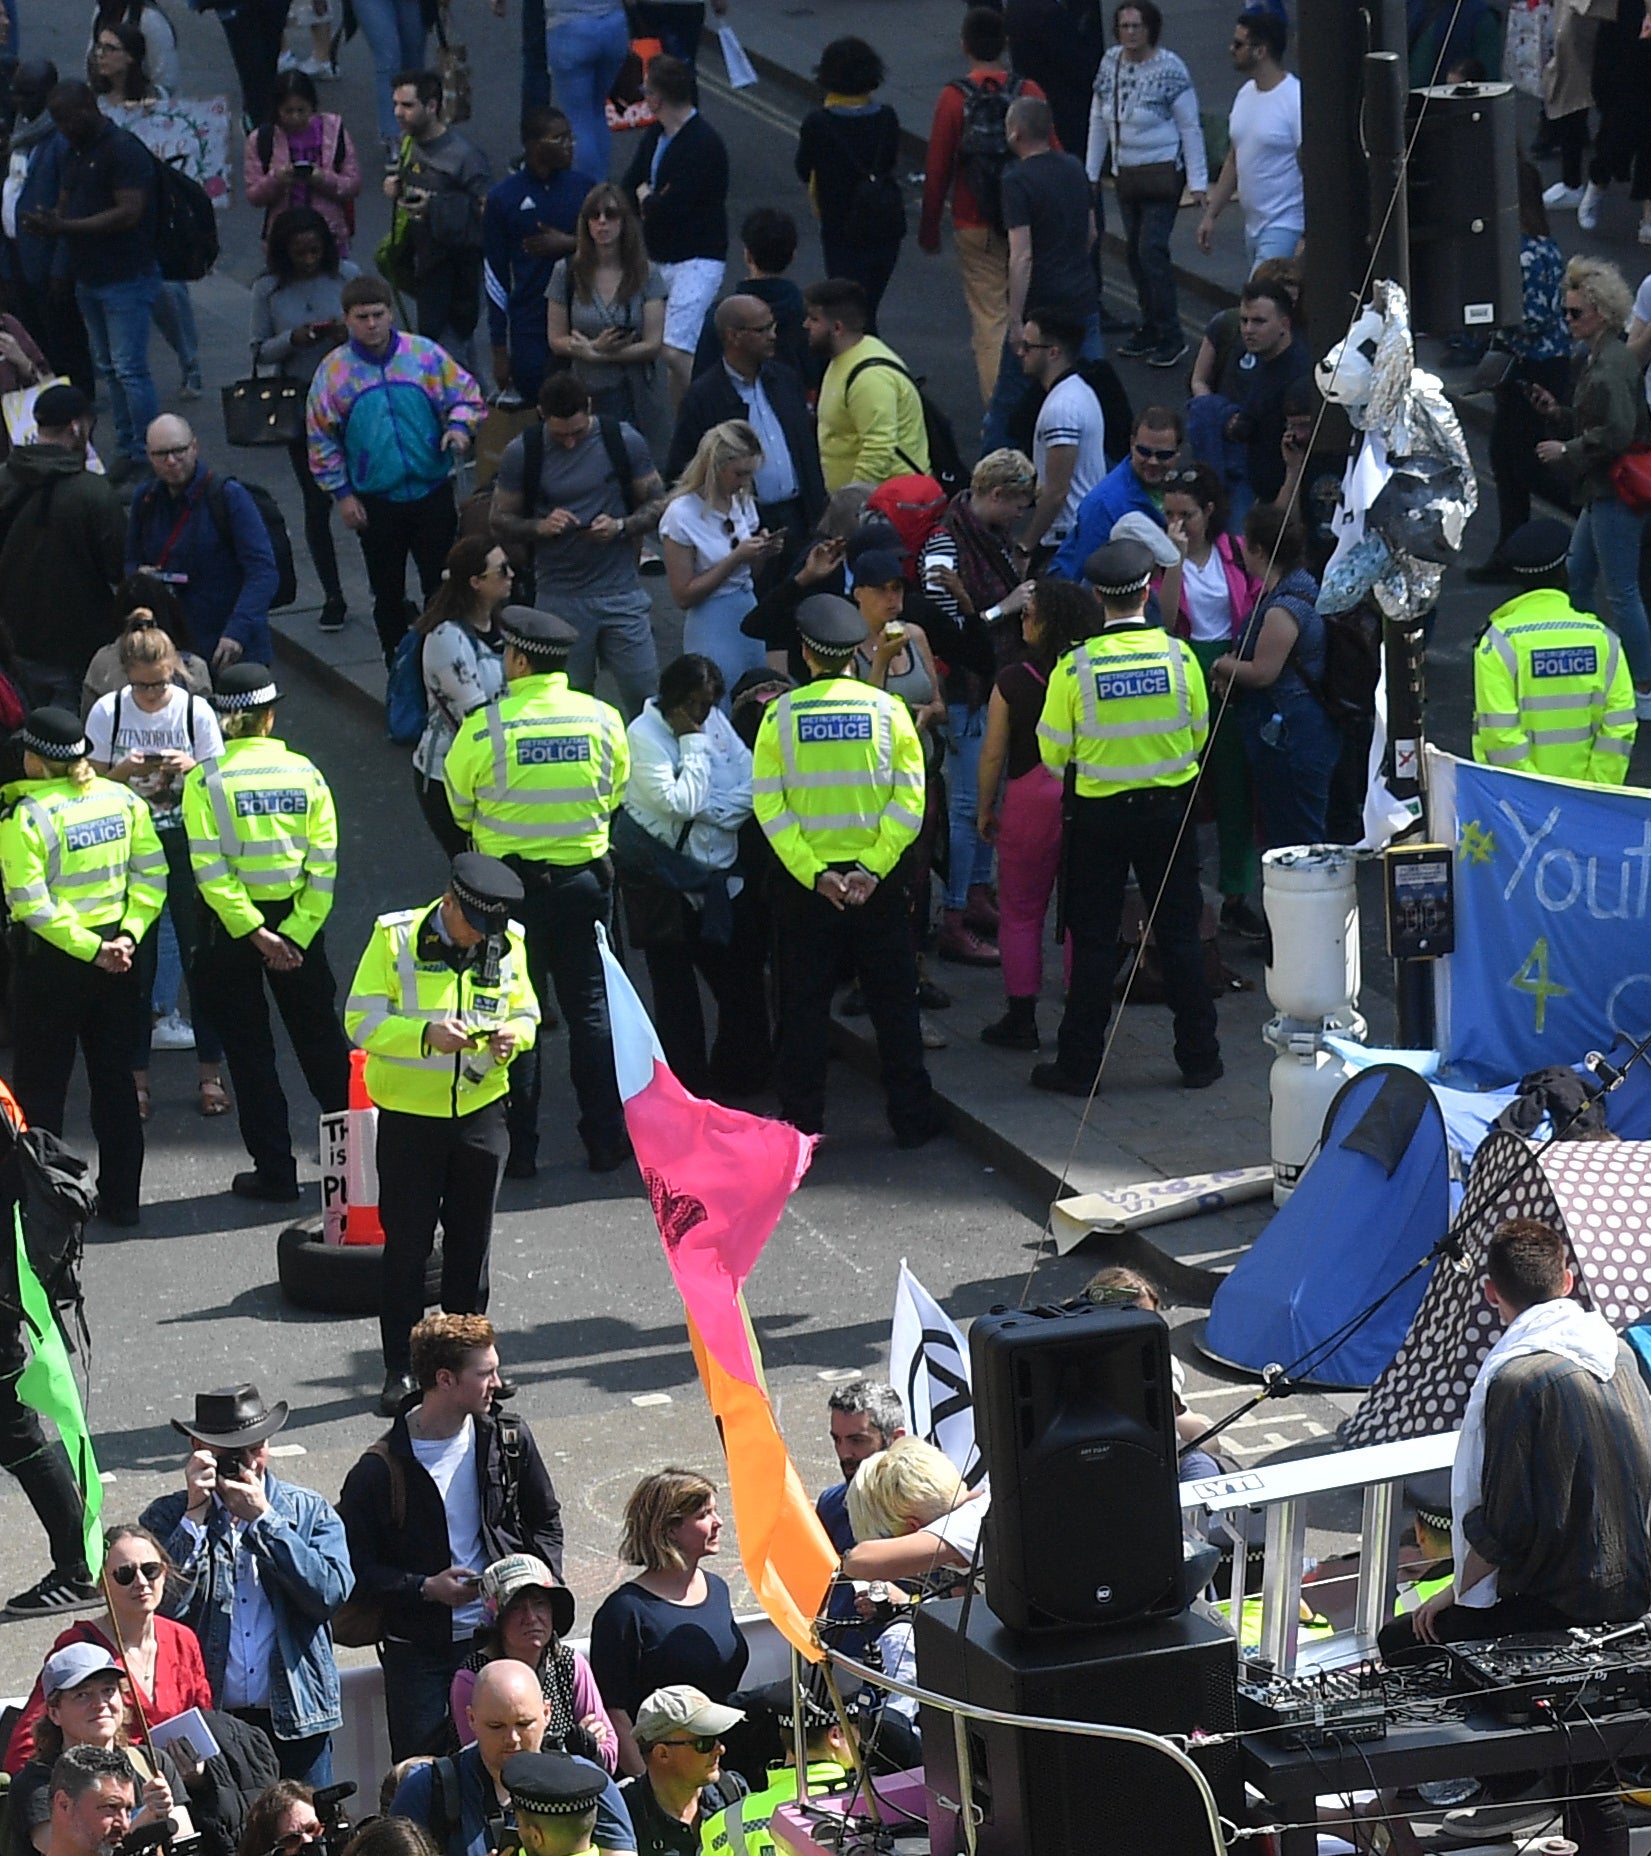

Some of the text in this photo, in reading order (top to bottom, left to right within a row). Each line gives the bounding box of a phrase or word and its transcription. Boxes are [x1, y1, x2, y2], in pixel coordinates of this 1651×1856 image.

[1097, 668, 1168, 683] METROPOLITAN
[1532, 657, 1597, 676] POLICE
[1099, 679, 1171, 699] POLICE
[800, 715, 869, 727] METROPOLITAN
[800, 724, 871, 741] POLICE
[519, 746, 589, 764] POLICE
[236, 798, 307, 814] POLICE
[67, 823, 126, 849] POLICE
[1511, 936, 1576, 1035] 4
[330, 1147, 347, 1167] is
